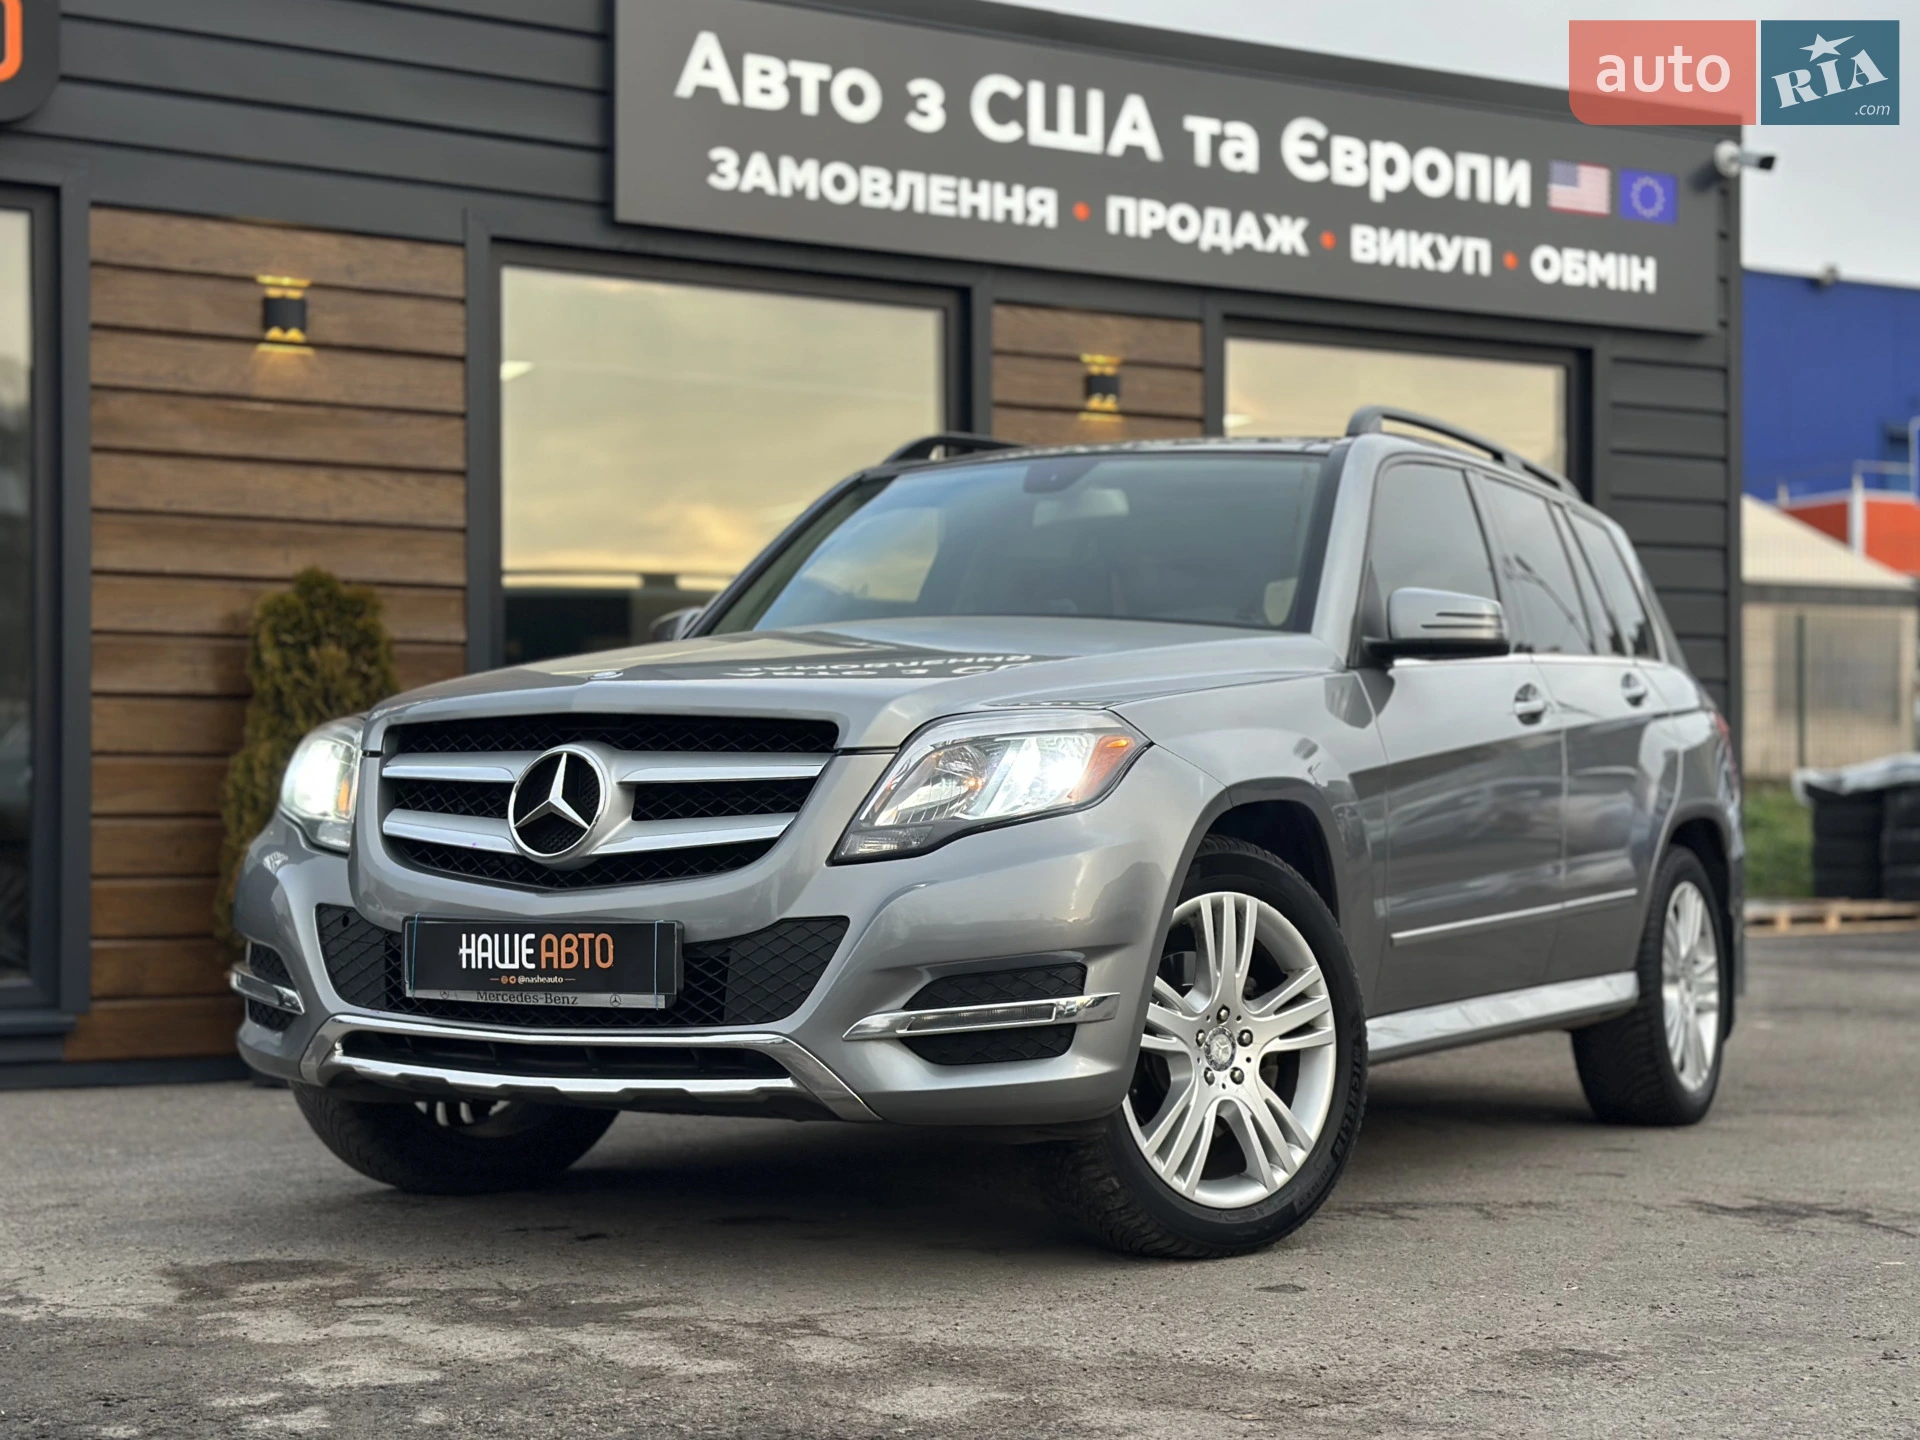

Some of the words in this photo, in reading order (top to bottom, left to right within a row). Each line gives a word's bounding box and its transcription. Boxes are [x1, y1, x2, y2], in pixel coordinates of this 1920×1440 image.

[970, 73, 1164, 162] США
[1183, 114, 1260, 174] та
[1281, 117, 1532, 208] Європи
[707, 146, 1058, 229] ЗАМОВЛЕННЯ
[1106, 195, 1309, 256] ПРОДАЖ
[1350, 224, 1492, 277] ВИКУП
[1530, 244, 1657, 293] ОБМІН
[459, 933, 536, 969] НАШЕ
[540, 933, 615, 969] АВТО
[476, 991, 579, 1005] Mercedes-Benz
[518, 975, 564, 985] @nasheauto
